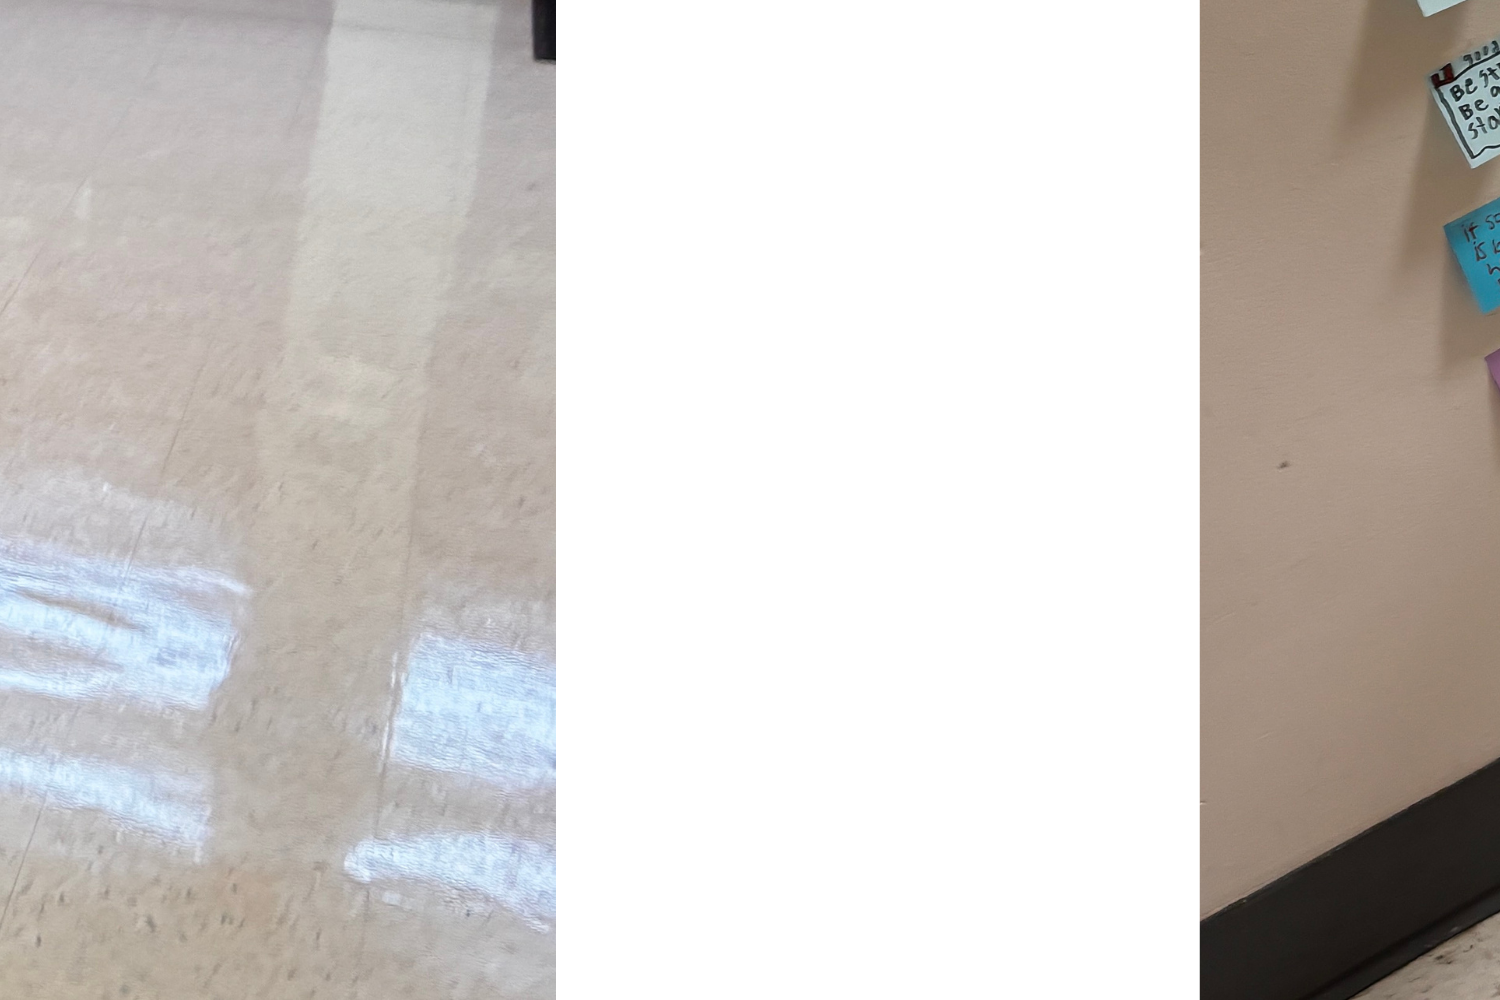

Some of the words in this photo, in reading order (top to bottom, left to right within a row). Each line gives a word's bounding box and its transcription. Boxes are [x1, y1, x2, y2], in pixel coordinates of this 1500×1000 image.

[1449, 77, 1479, 102] Be
[1458, 97, 1489, 121] Be
[1474, 241, 1488, 262] is
